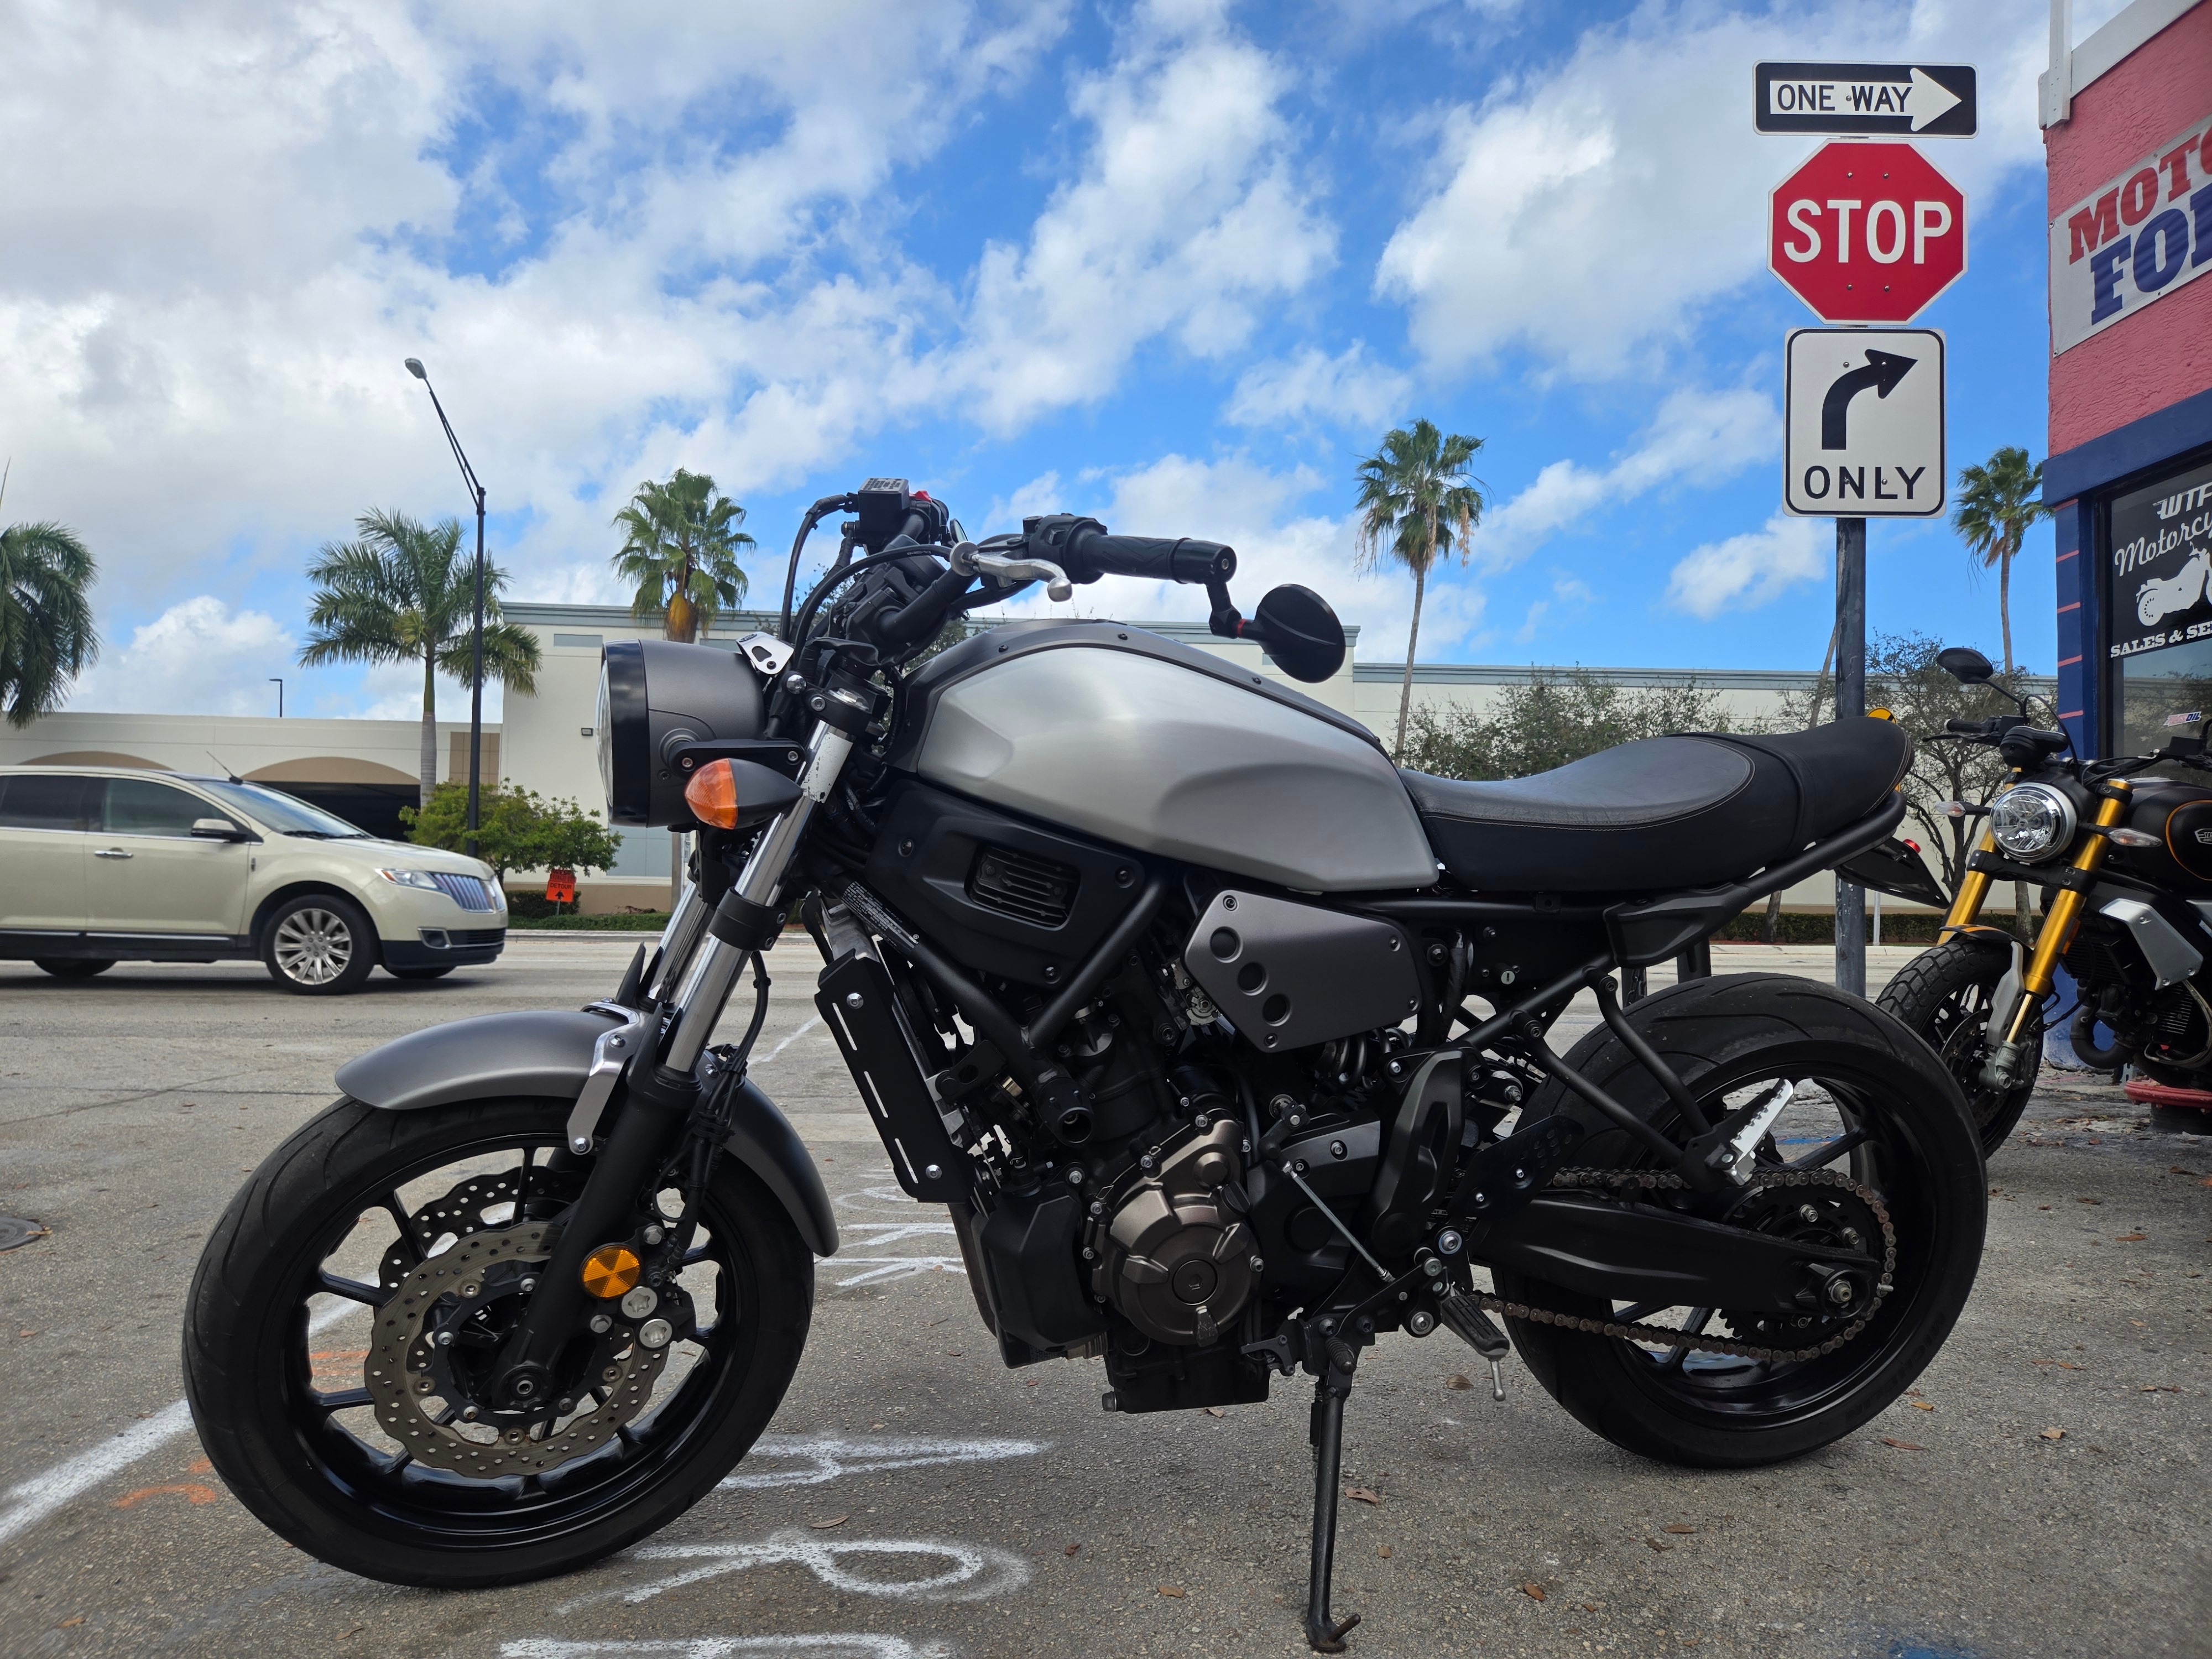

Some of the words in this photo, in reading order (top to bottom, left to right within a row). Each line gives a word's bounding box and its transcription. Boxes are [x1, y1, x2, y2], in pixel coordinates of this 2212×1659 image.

[1777, 84, 1835, 112] ONE
[1851, 85, 1912, 112] WAY
[1783, 199, 1952, 264] STOP
[1804, 465, 1926, 500] ONLY
[2110, 633, 2166, 658] SALES
[2168, 629, 2184, 644] &
[2186, 620, 2212, 639] SE
